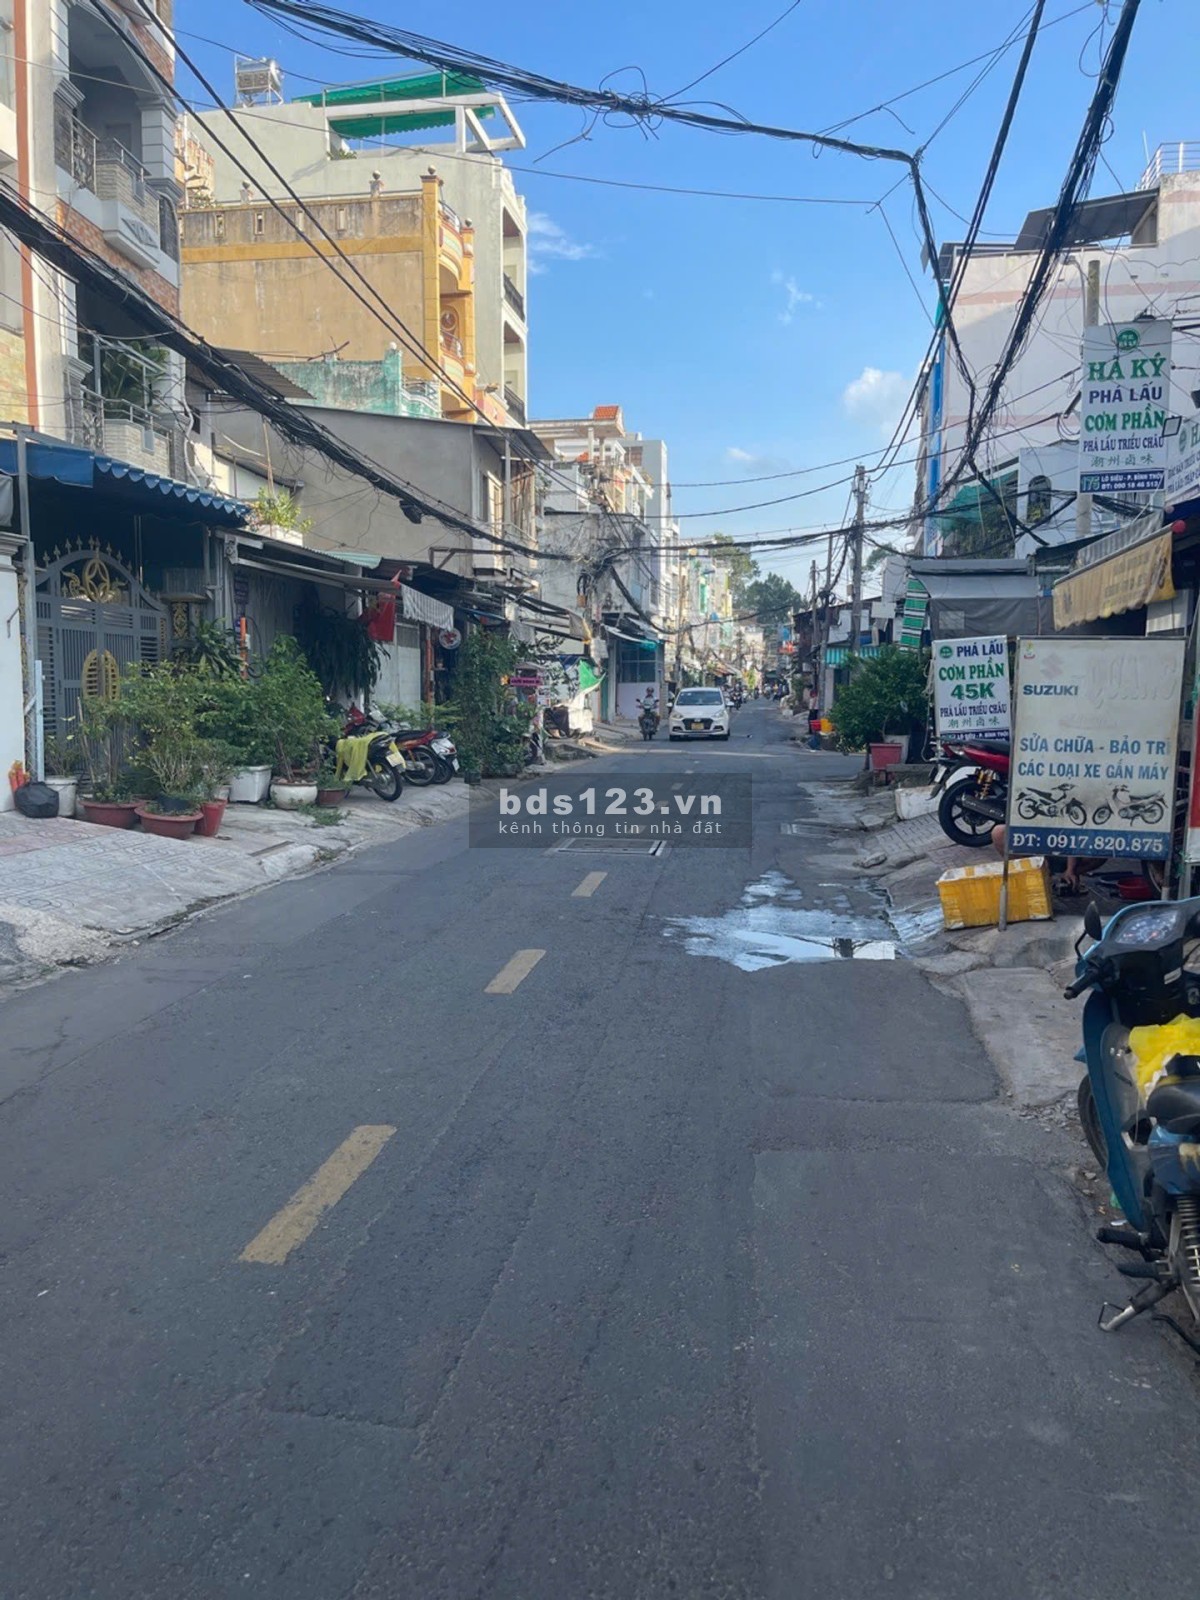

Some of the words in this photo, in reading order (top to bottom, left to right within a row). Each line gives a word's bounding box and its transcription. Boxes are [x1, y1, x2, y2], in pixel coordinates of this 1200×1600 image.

[1089, 384, 1123, 403] PHÁ
[1130, 381, 1162, 401] LẤU
[1084, 411, 1117, 432] CƠM
[1122, 403, 1165, 430] PHẦN
[957, 641, 979, 657] PHÁ
[982, 639, 1003, 656] LẤU
[939, 664, 965, 681] CƠM
[969, 657, 1004, 679] PHẦN
[950, 682, 995, 700] 45K
[1023, 684, 1079, 697] SUZUKI
[1020, 733, 1048, 752] SỬA
[1054, 735, 1094, 754] CHỮA
[1109, 735, 1141, 755] BẢO
[1018, 759, 1045, 776] CÁC
[1049, 763, 1079, 779] LOẠI
[1084, 764, 1101, 778] XE
[1138, 762, 1169, 780] MÁY
[1012, 833, 1040, 847] ĐT:
[1047, 834, 1163, 852] 0917.820.875
